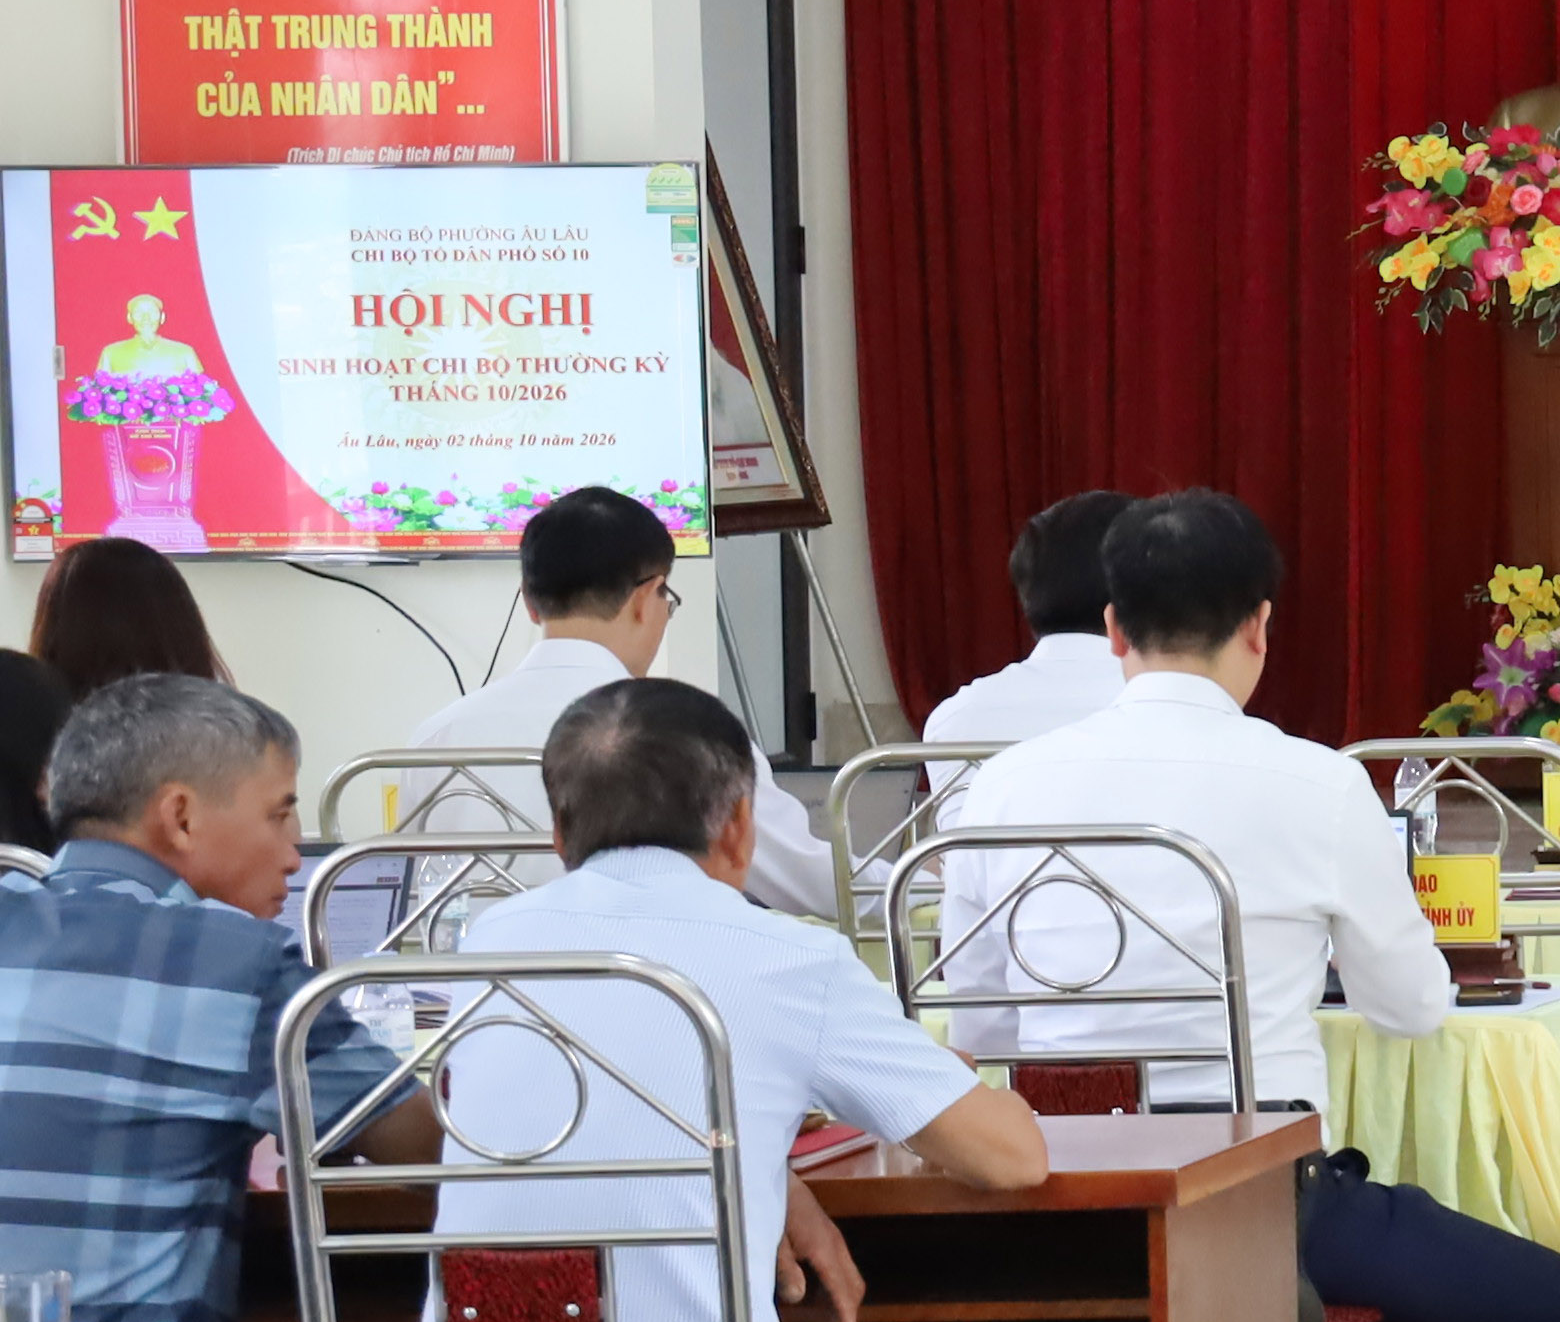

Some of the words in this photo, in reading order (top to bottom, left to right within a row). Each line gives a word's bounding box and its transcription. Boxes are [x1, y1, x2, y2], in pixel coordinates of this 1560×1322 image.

[182, 8, 263, 58] THẬT
[269, 14, 378, 49] TRUNG
[387, 7, 493, 47] THÀNH
[350, 288, 445, 337] HỘI
[461, 293, 594, 336] NGHỊ
[279, 359, 336, 374] SINH
[346, 358, 416, 379] HOẠT
[422, 358, 467, 375] CHI
[635, 351, 669, 373] KỲ
[389, 380, 478, 402] THÁNG
[488, 384, 567, 401] 10/2026
[1457, 901, 1475, 927] ỦY
